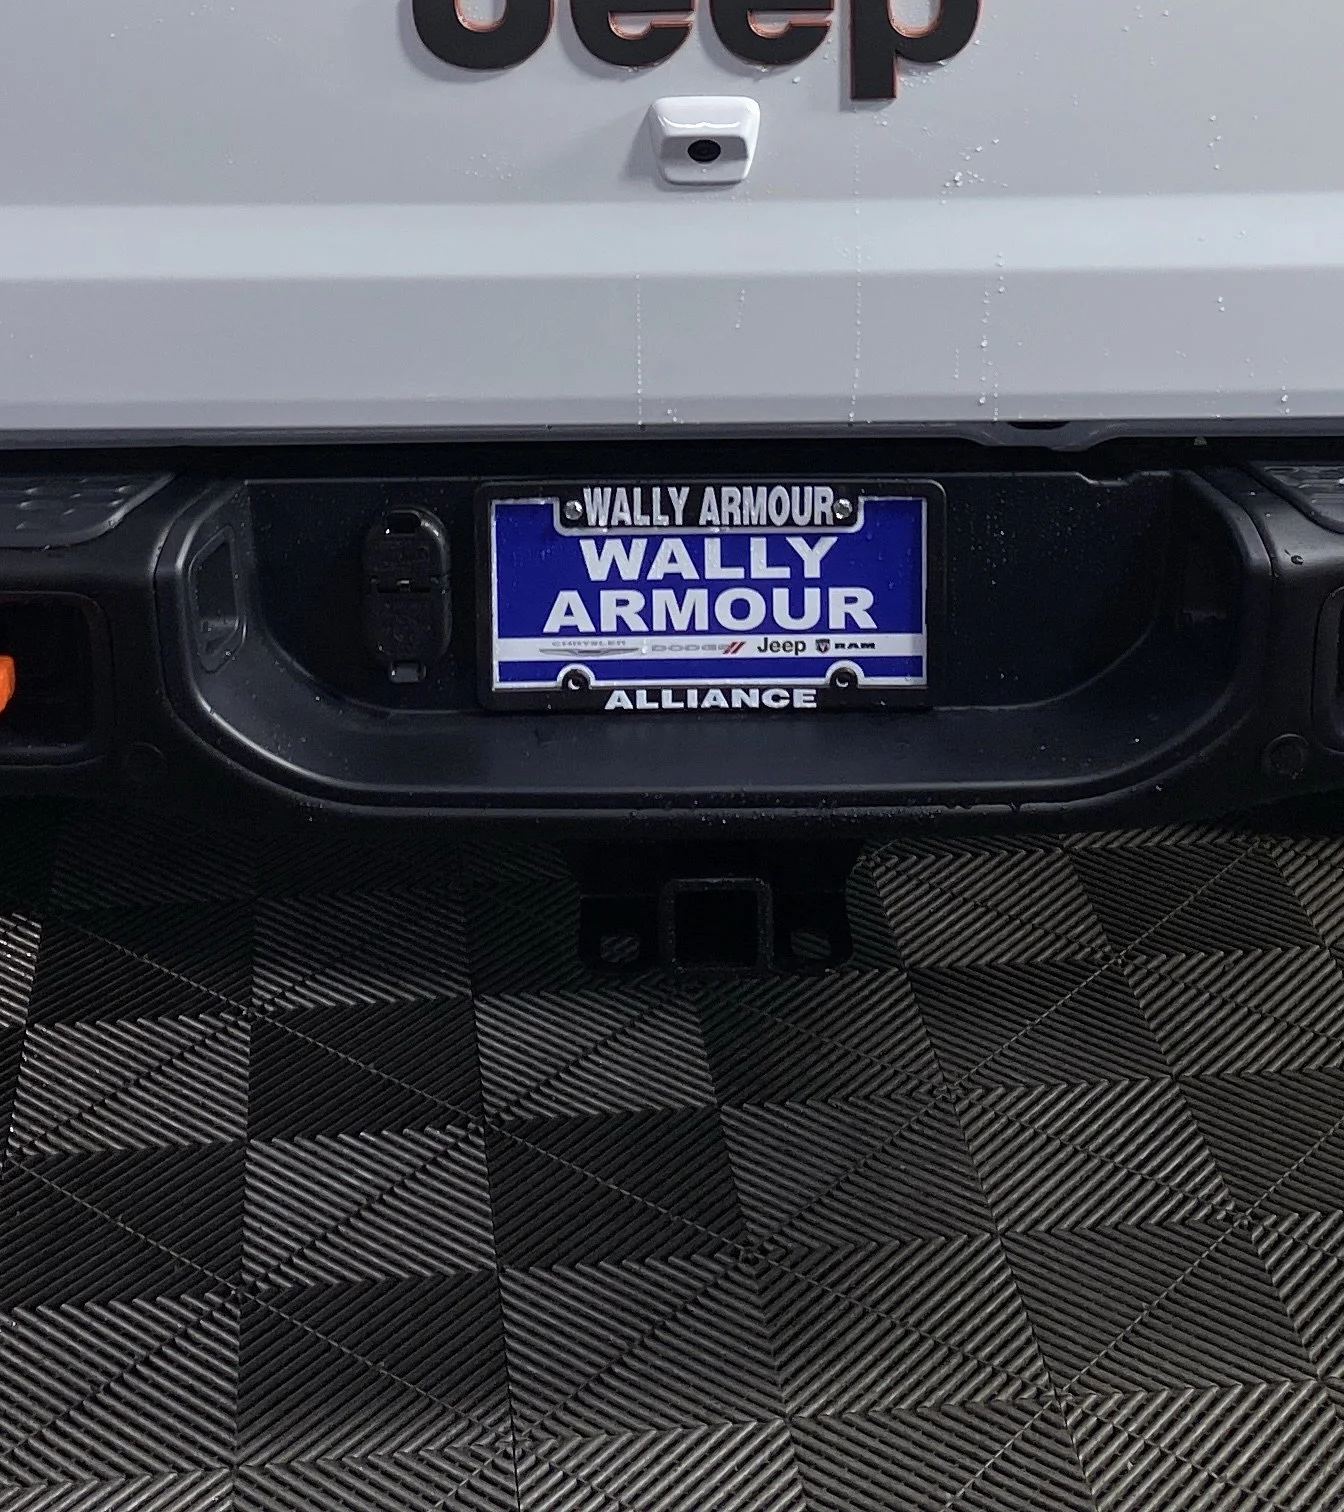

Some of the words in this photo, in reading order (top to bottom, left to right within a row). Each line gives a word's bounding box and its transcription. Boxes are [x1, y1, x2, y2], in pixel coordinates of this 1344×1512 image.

[582, 486, 689, 527] WALLY
[699, 485, 835, 527] ARMOUR
[579, 536, 839, 582] WALLY
[542, 587, 877, 633] ARMOUR
[757, 637, 806, 656] Jeep
[834, 642, 876, 650] RAM
[604, 688, 818, 710] ALLIANCE
